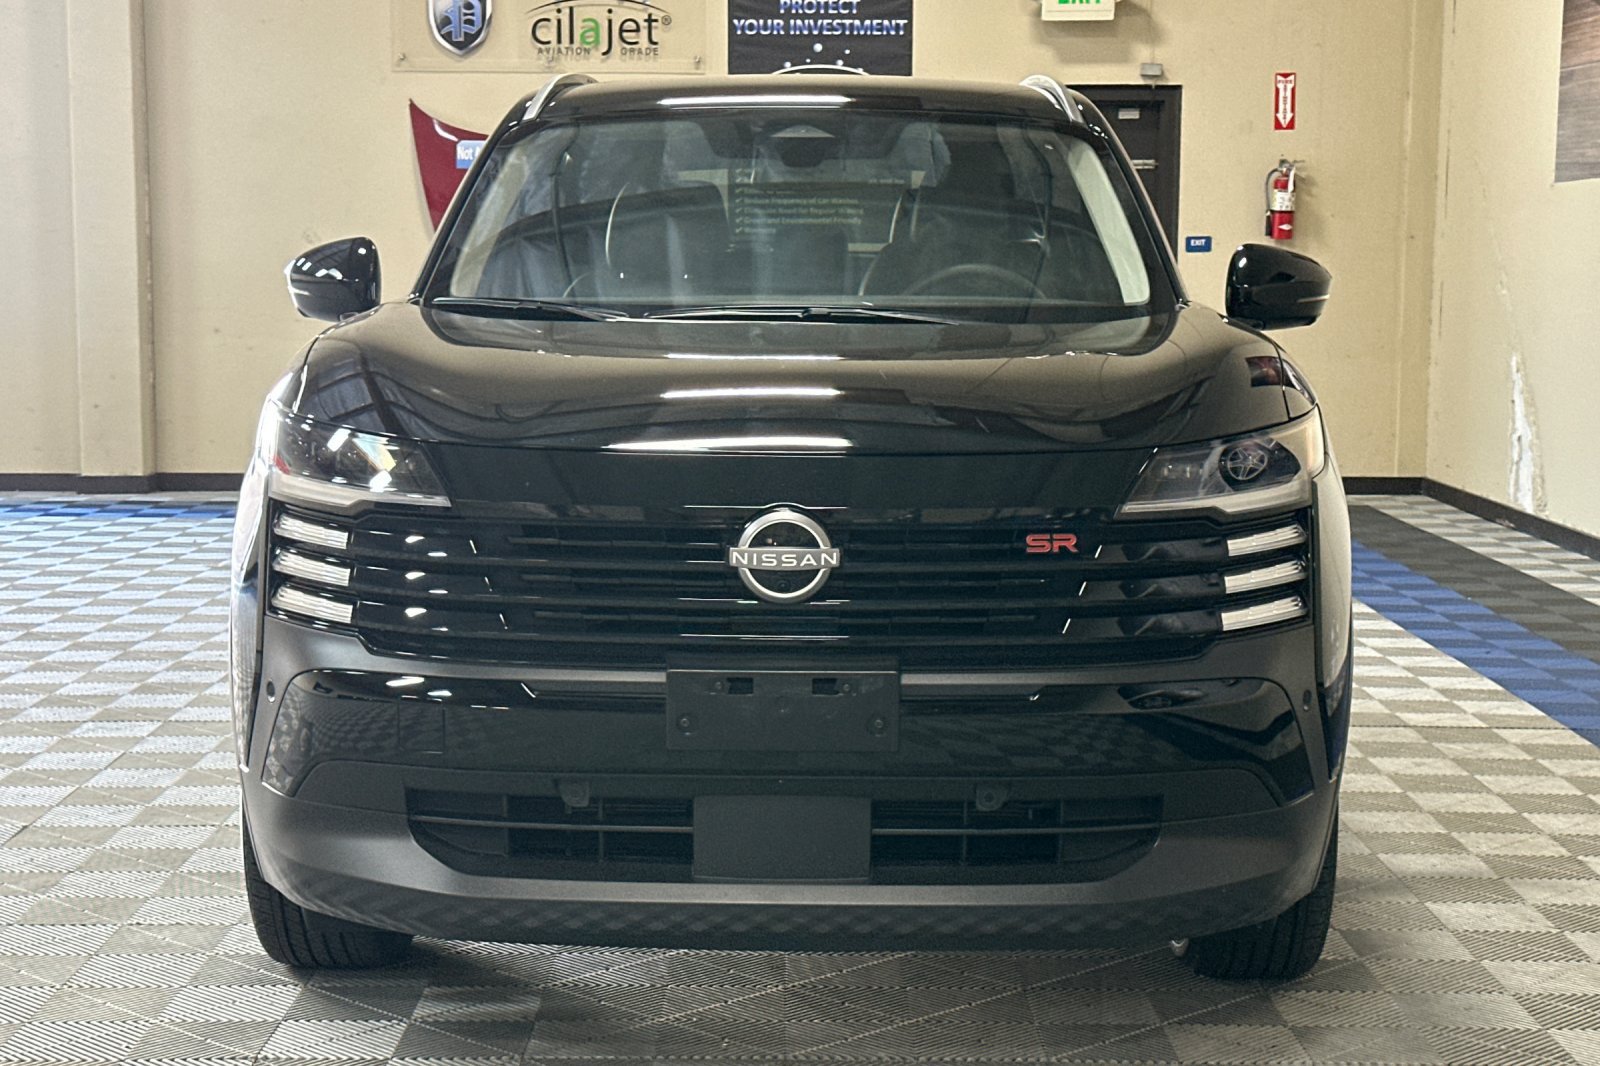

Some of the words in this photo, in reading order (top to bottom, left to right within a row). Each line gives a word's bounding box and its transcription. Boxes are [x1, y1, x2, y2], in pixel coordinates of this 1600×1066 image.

[779, 0, 861, 14] PROTECT
[732, 19, 785, 35] YOUR
[789, 19, 908, 36] INVESTMENT
[537, 47, 592, 56] AVIATION
[620, 47, 659, 56] GRADE
[457, 146, 474, 160] Not
[1025, 534, 1078, 553] SR
[731, 551, 838, 567] NISSAN
